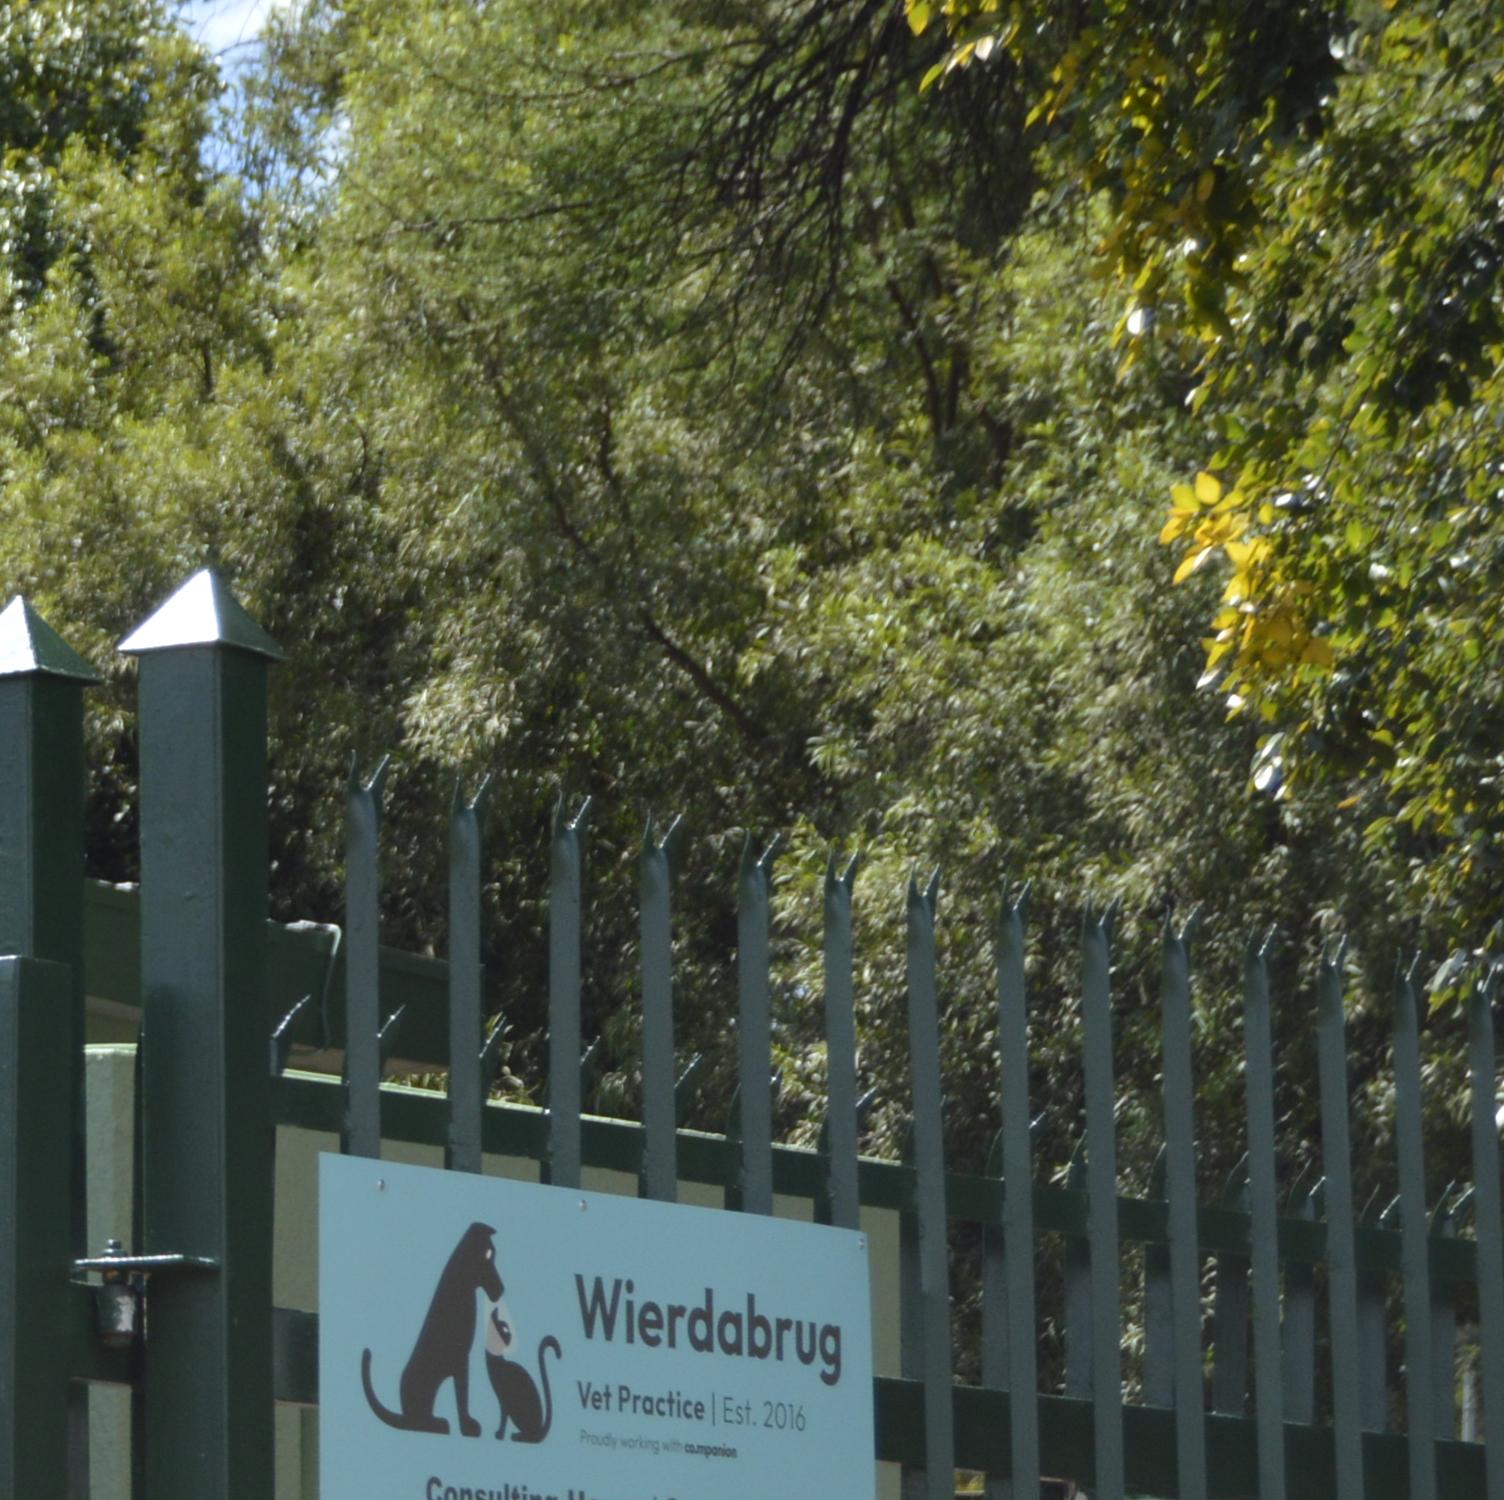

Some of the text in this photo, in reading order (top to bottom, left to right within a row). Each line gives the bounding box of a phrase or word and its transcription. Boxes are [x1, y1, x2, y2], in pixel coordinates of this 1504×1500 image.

[574, 1273, 842, 1386] Wierdabrug
[577, 1380, 612, 1412] Vet
[617, 1386, 705, 1420] Practice
[722, 1397, 757, 1427] Est.
[763, 1401, 806, 1432] 2016
[579, 1429, 617, 1450] Proudly
[621, 1434, 660, 1455] working
[662, 1438, 682, 1452] with
